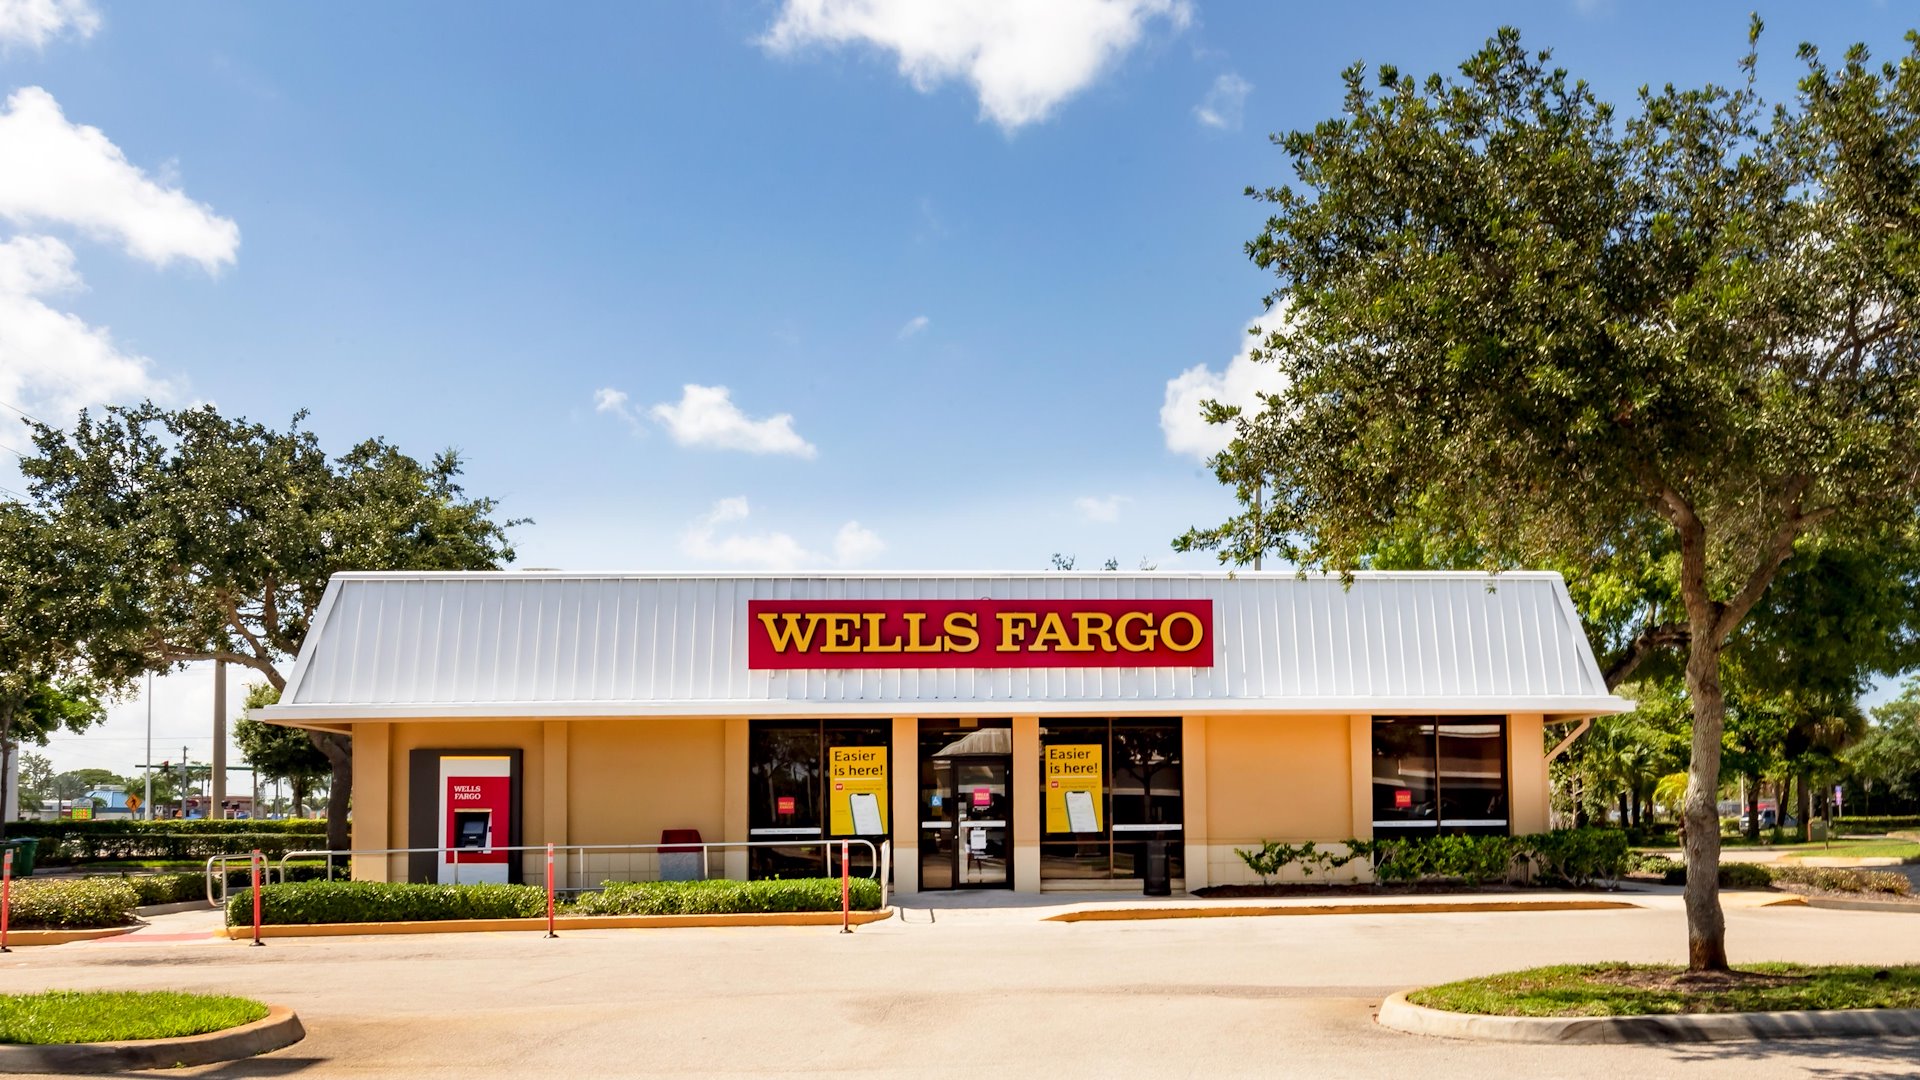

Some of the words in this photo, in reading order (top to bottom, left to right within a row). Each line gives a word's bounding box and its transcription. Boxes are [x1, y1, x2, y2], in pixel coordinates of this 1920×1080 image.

[757, 612, 980, 653] WELLS
[995, 611, 1204, 652] FARGO
[834, 750, 876, 761] Easier
[1050, 748, 1091, 760] Easier
[834, 765, 845, 776] is
[849, 765, 883, 776] here!
[1050, 763, 1060, 774] is
[1064, 763, 1098, 774] here!
